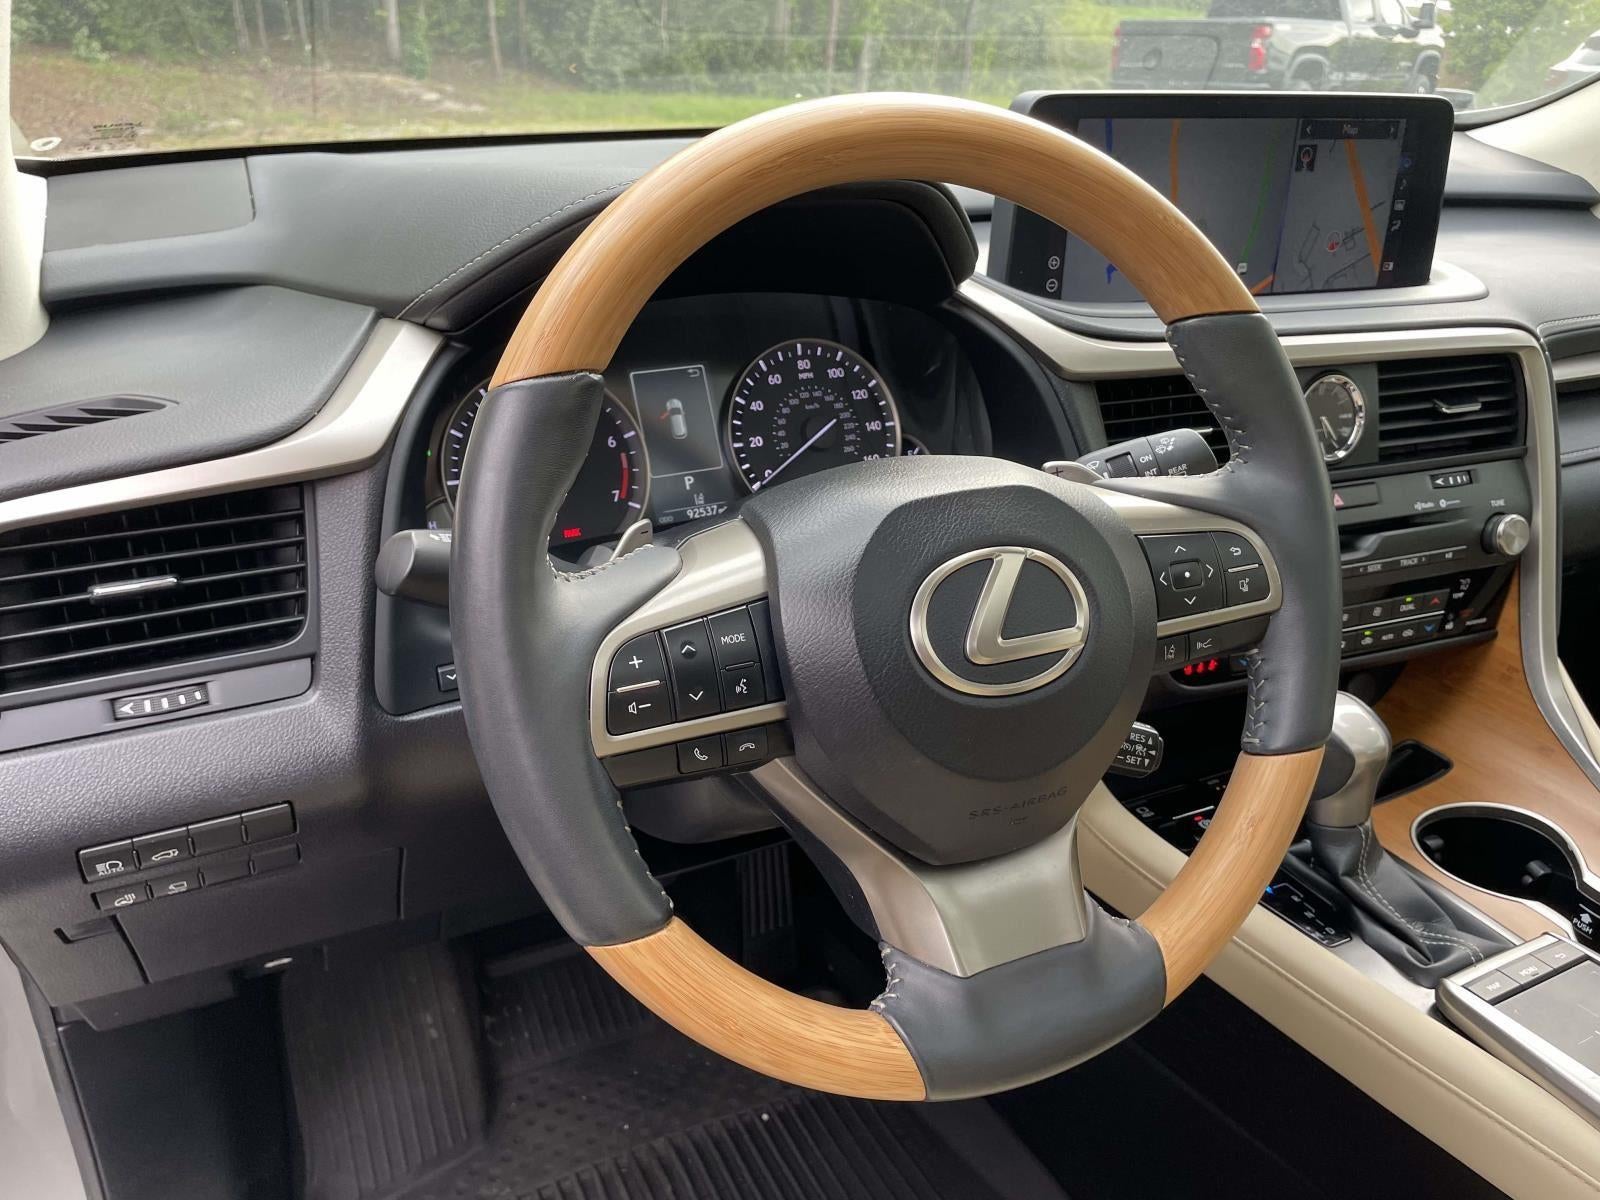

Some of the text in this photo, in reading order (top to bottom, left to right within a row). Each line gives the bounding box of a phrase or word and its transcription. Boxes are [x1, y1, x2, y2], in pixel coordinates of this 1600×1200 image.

[797, 359, 811, 370] 80
[798, 372, 814, 380] MPH
[826, 367, 845, 379] 100
[767, 374, 782, 385] 60
[851, 389, 868, 400] 120
[750, 400, 764, 412] 40
[865, 420, 882, 432] 140
[607, 436, 617, 448] 6
[749, 436, 763, 448] 20
[1140, 455, 1153, 463] ON
[1144, 467, 1157, 477] INT
[1168, 463, 1188, 476] REAR
[683, 475, 695, 491] P
[611, 490, 620, 502] 7
[1490, 498, 1505, 508] TUNE
[686, 504, 718, 519] 92537
[1400, 557, 1419, 567] TRACK
[1367, 563, 1382, 573] SEEK
[720, 633, 747, 645] MODE
[1129, 732, 1146, 743] RES
[1126, 755, 1141, 766] SET
[99, 866, 124, 876] AUTO
[1572, 917, 1593, 935] PUSH
